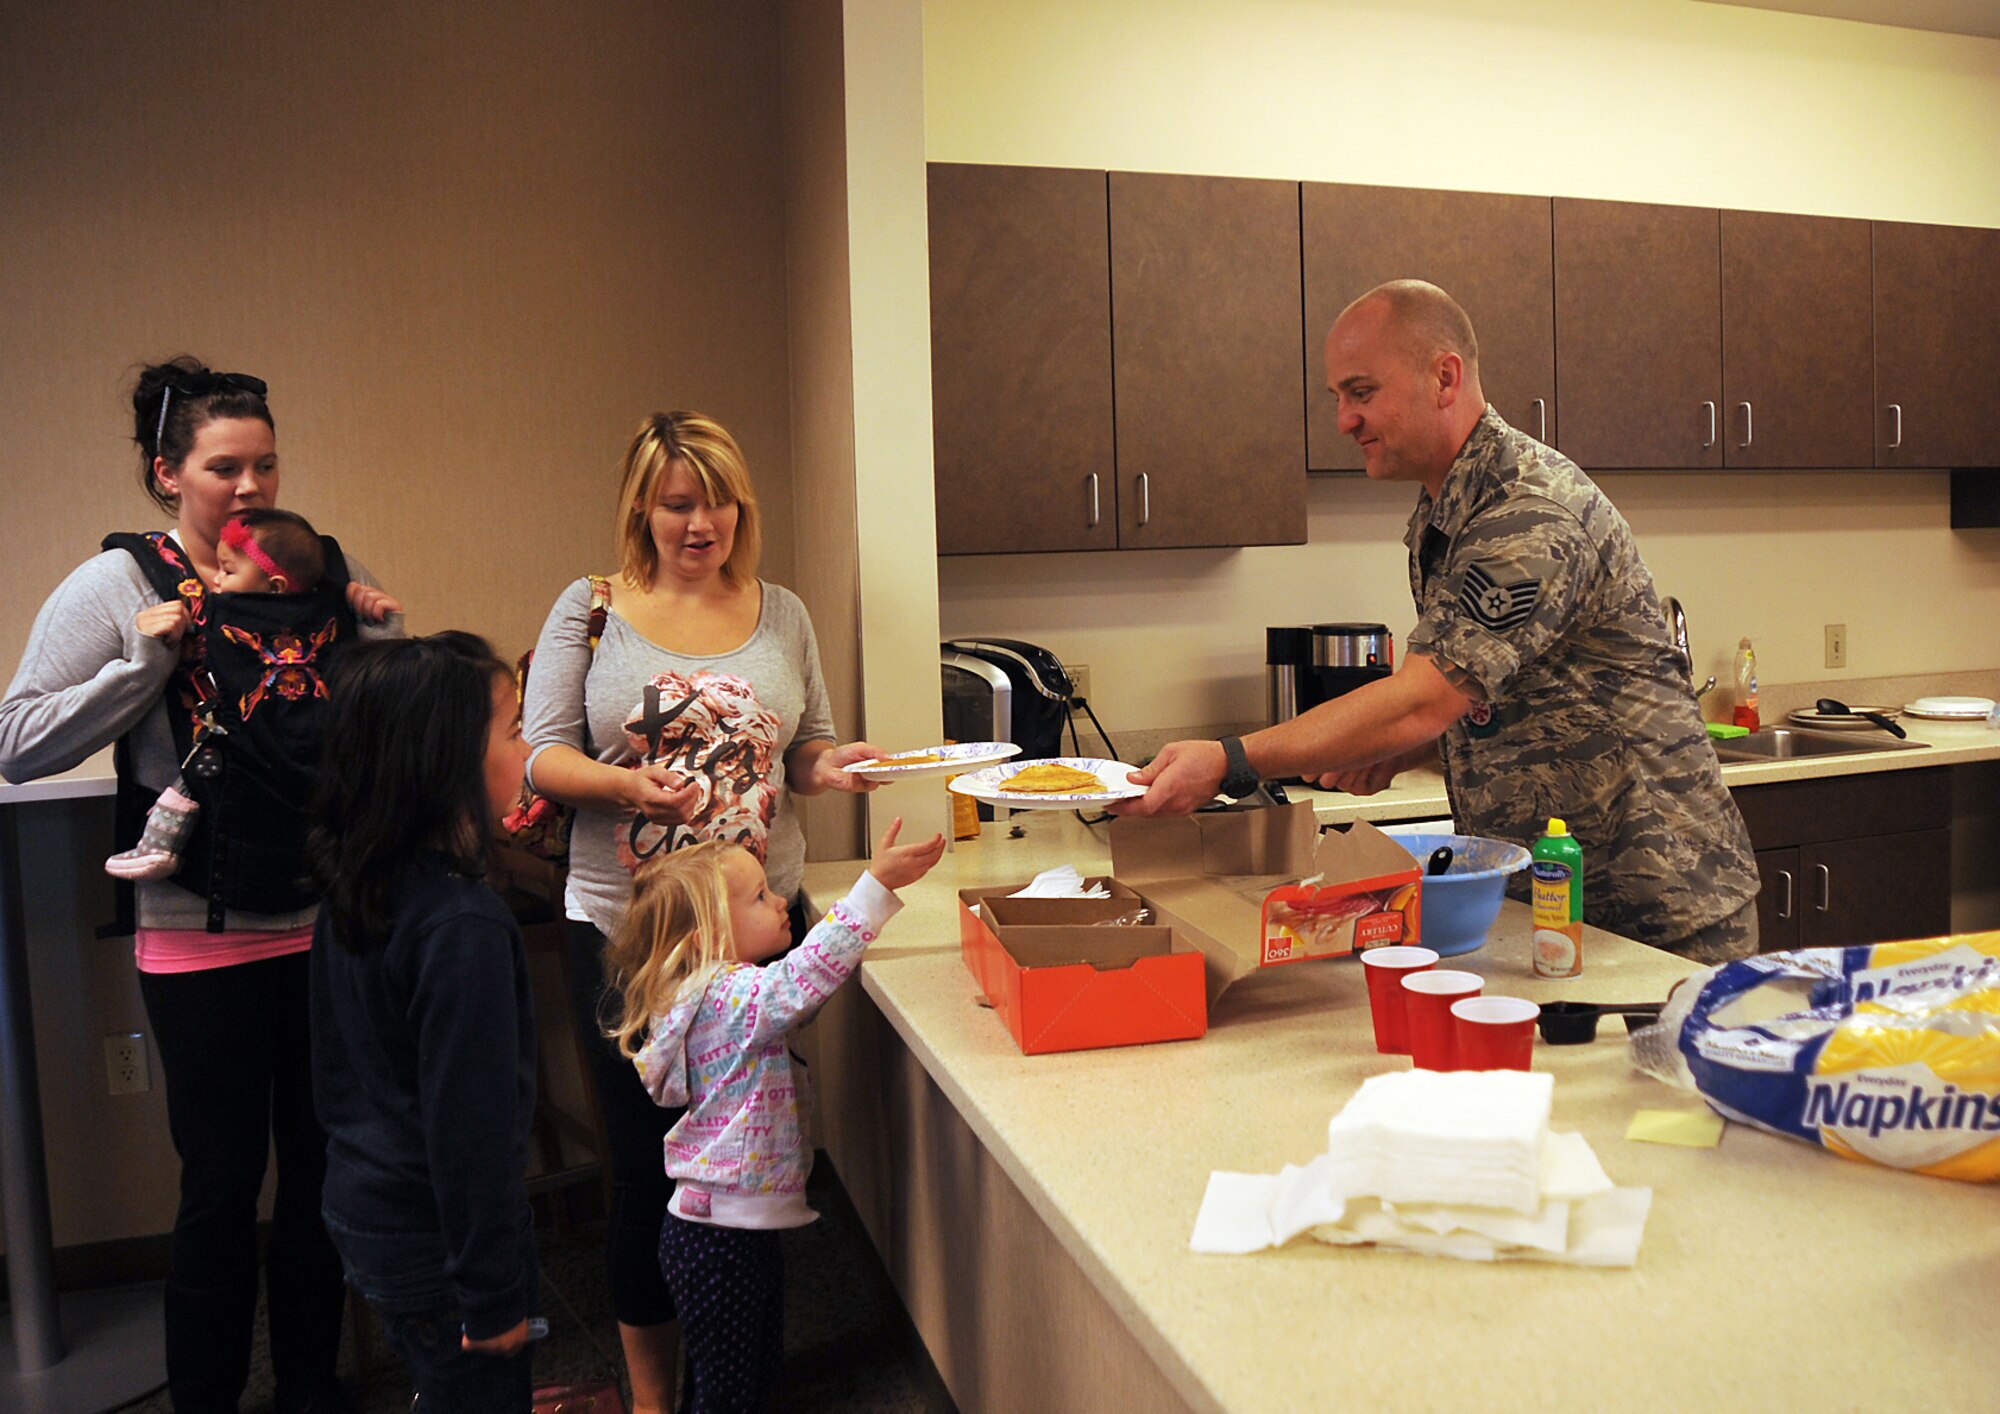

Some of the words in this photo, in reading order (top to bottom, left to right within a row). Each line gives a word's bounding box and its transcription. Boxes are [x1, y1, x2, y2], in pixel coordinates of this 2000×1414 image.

[1361, 925, 1398, 937] CUTLERY
[1268, 947, 1290, 959] 360
[1857, 1074, 1907, 1086] Everyday
